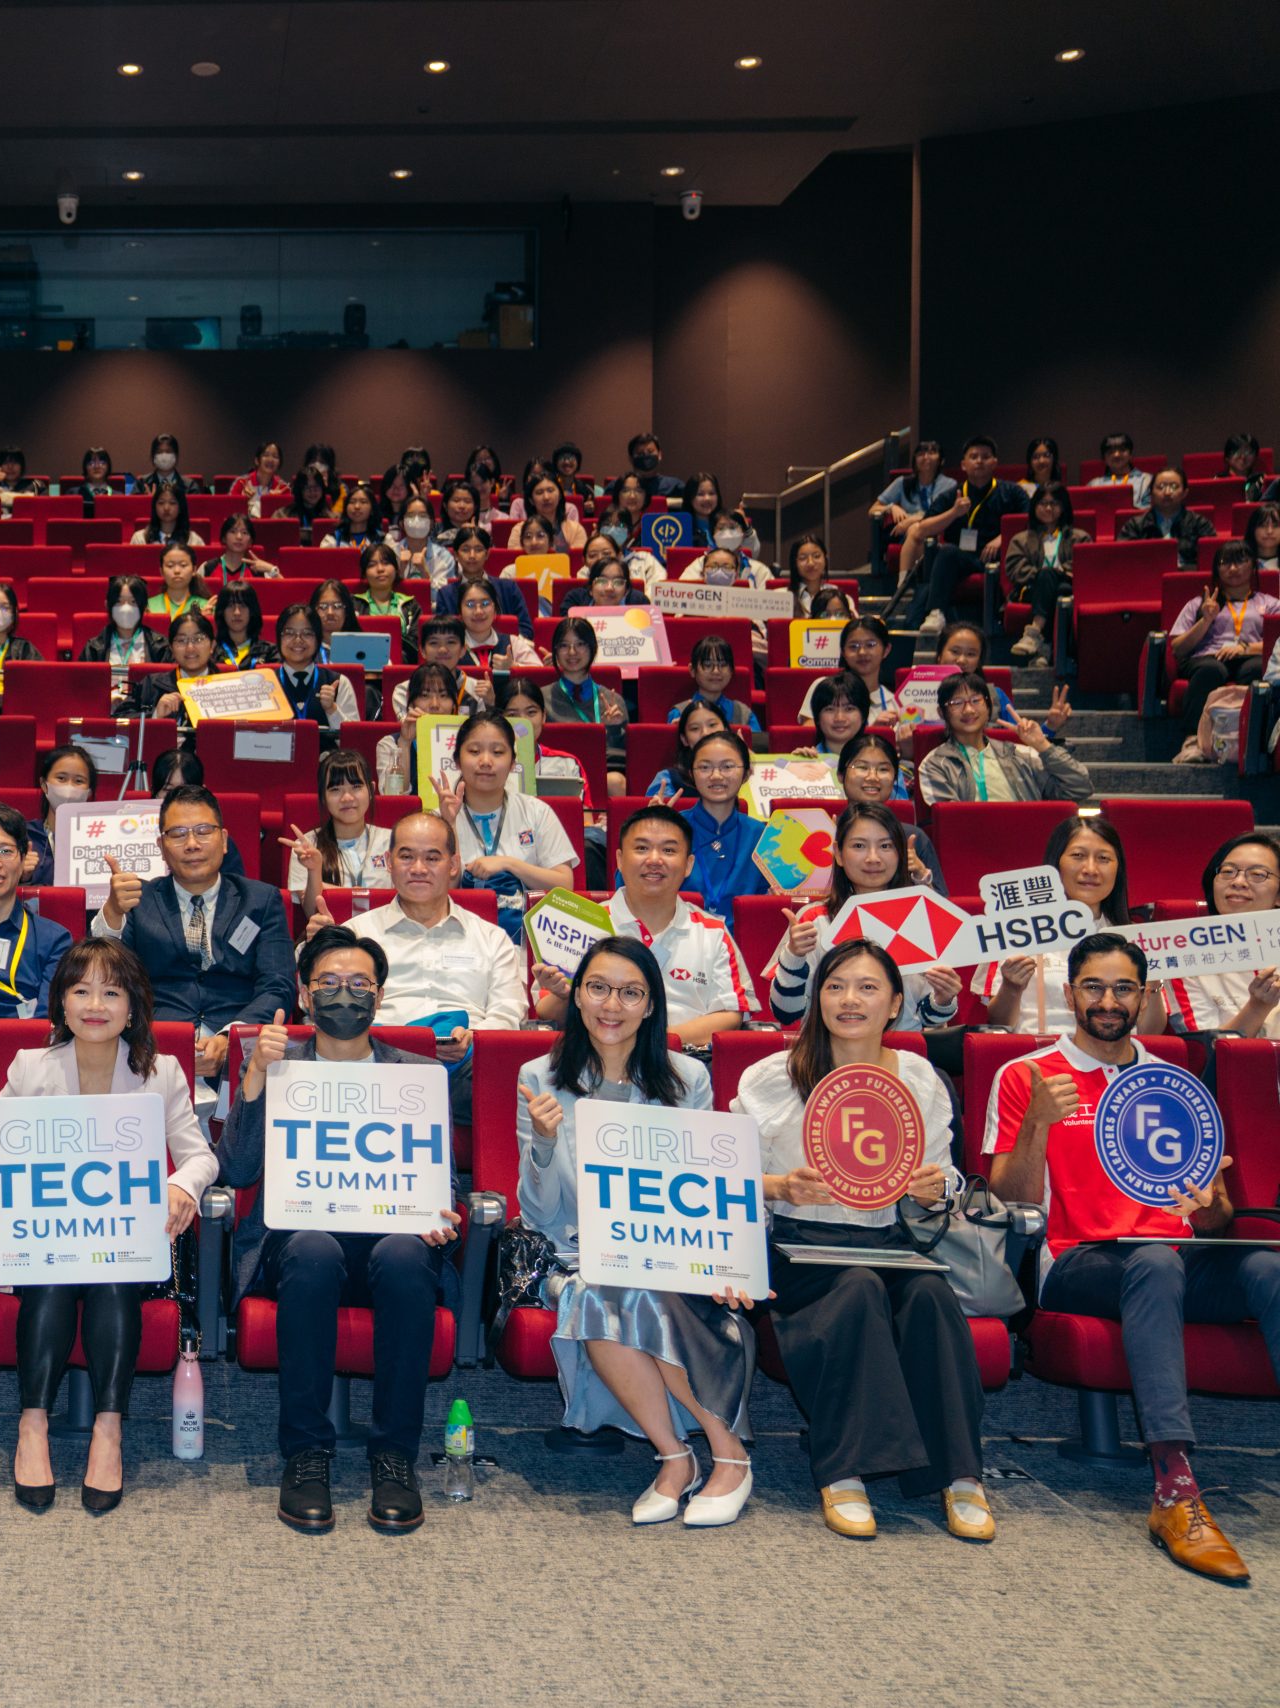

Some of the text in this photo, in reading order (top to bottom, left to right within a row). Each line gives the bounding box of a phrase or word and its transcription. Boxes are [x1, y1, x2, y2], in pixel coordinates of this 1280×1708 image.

[654, 585, 723, 602] FutureGEN
[815, 635, 829, 650] #
[798, 655, 839, 667] Commu
[904, 688, 938, 697] COMM
[761, 768, 777, 781] #
[759, 785, 806, 798] People
[86, 820, 106, 838] #
[124, 843, 162, 857] Skills
[554, 940, 562, 949] BE
[976, 910, 1087, 954] HSBC
[1131, 923, 1247, 953] tureGEN
[286, 1080, 426, 1115] GIRLS
[1110, 1077, 1147, 1113] AWARD
[1163, 1076, 1215, 1139] FUTUREGEN
[0, 1116, 143, 1155] GIRLS
[273, 1119, 443, 1164] TECH
[596, 1122, 738, 1168] GIRLS
[812, 1077, 916, 1197] FUTUREGEN YOUNG WOMEN LEADERS AWARD
[841, 1106, 886, 1166] FG
[1104, 1117, 1127, 1171] LEADERS
[1135, 1104, 1182, 1165] FG
[296, 1170, 417, 1191] SUMMIT
[584, 1163, 758, 1223] TECH
[12, 1217, 136, 1239] SUMMIT
[611, 1221, 733, 1251] SUMMIT
